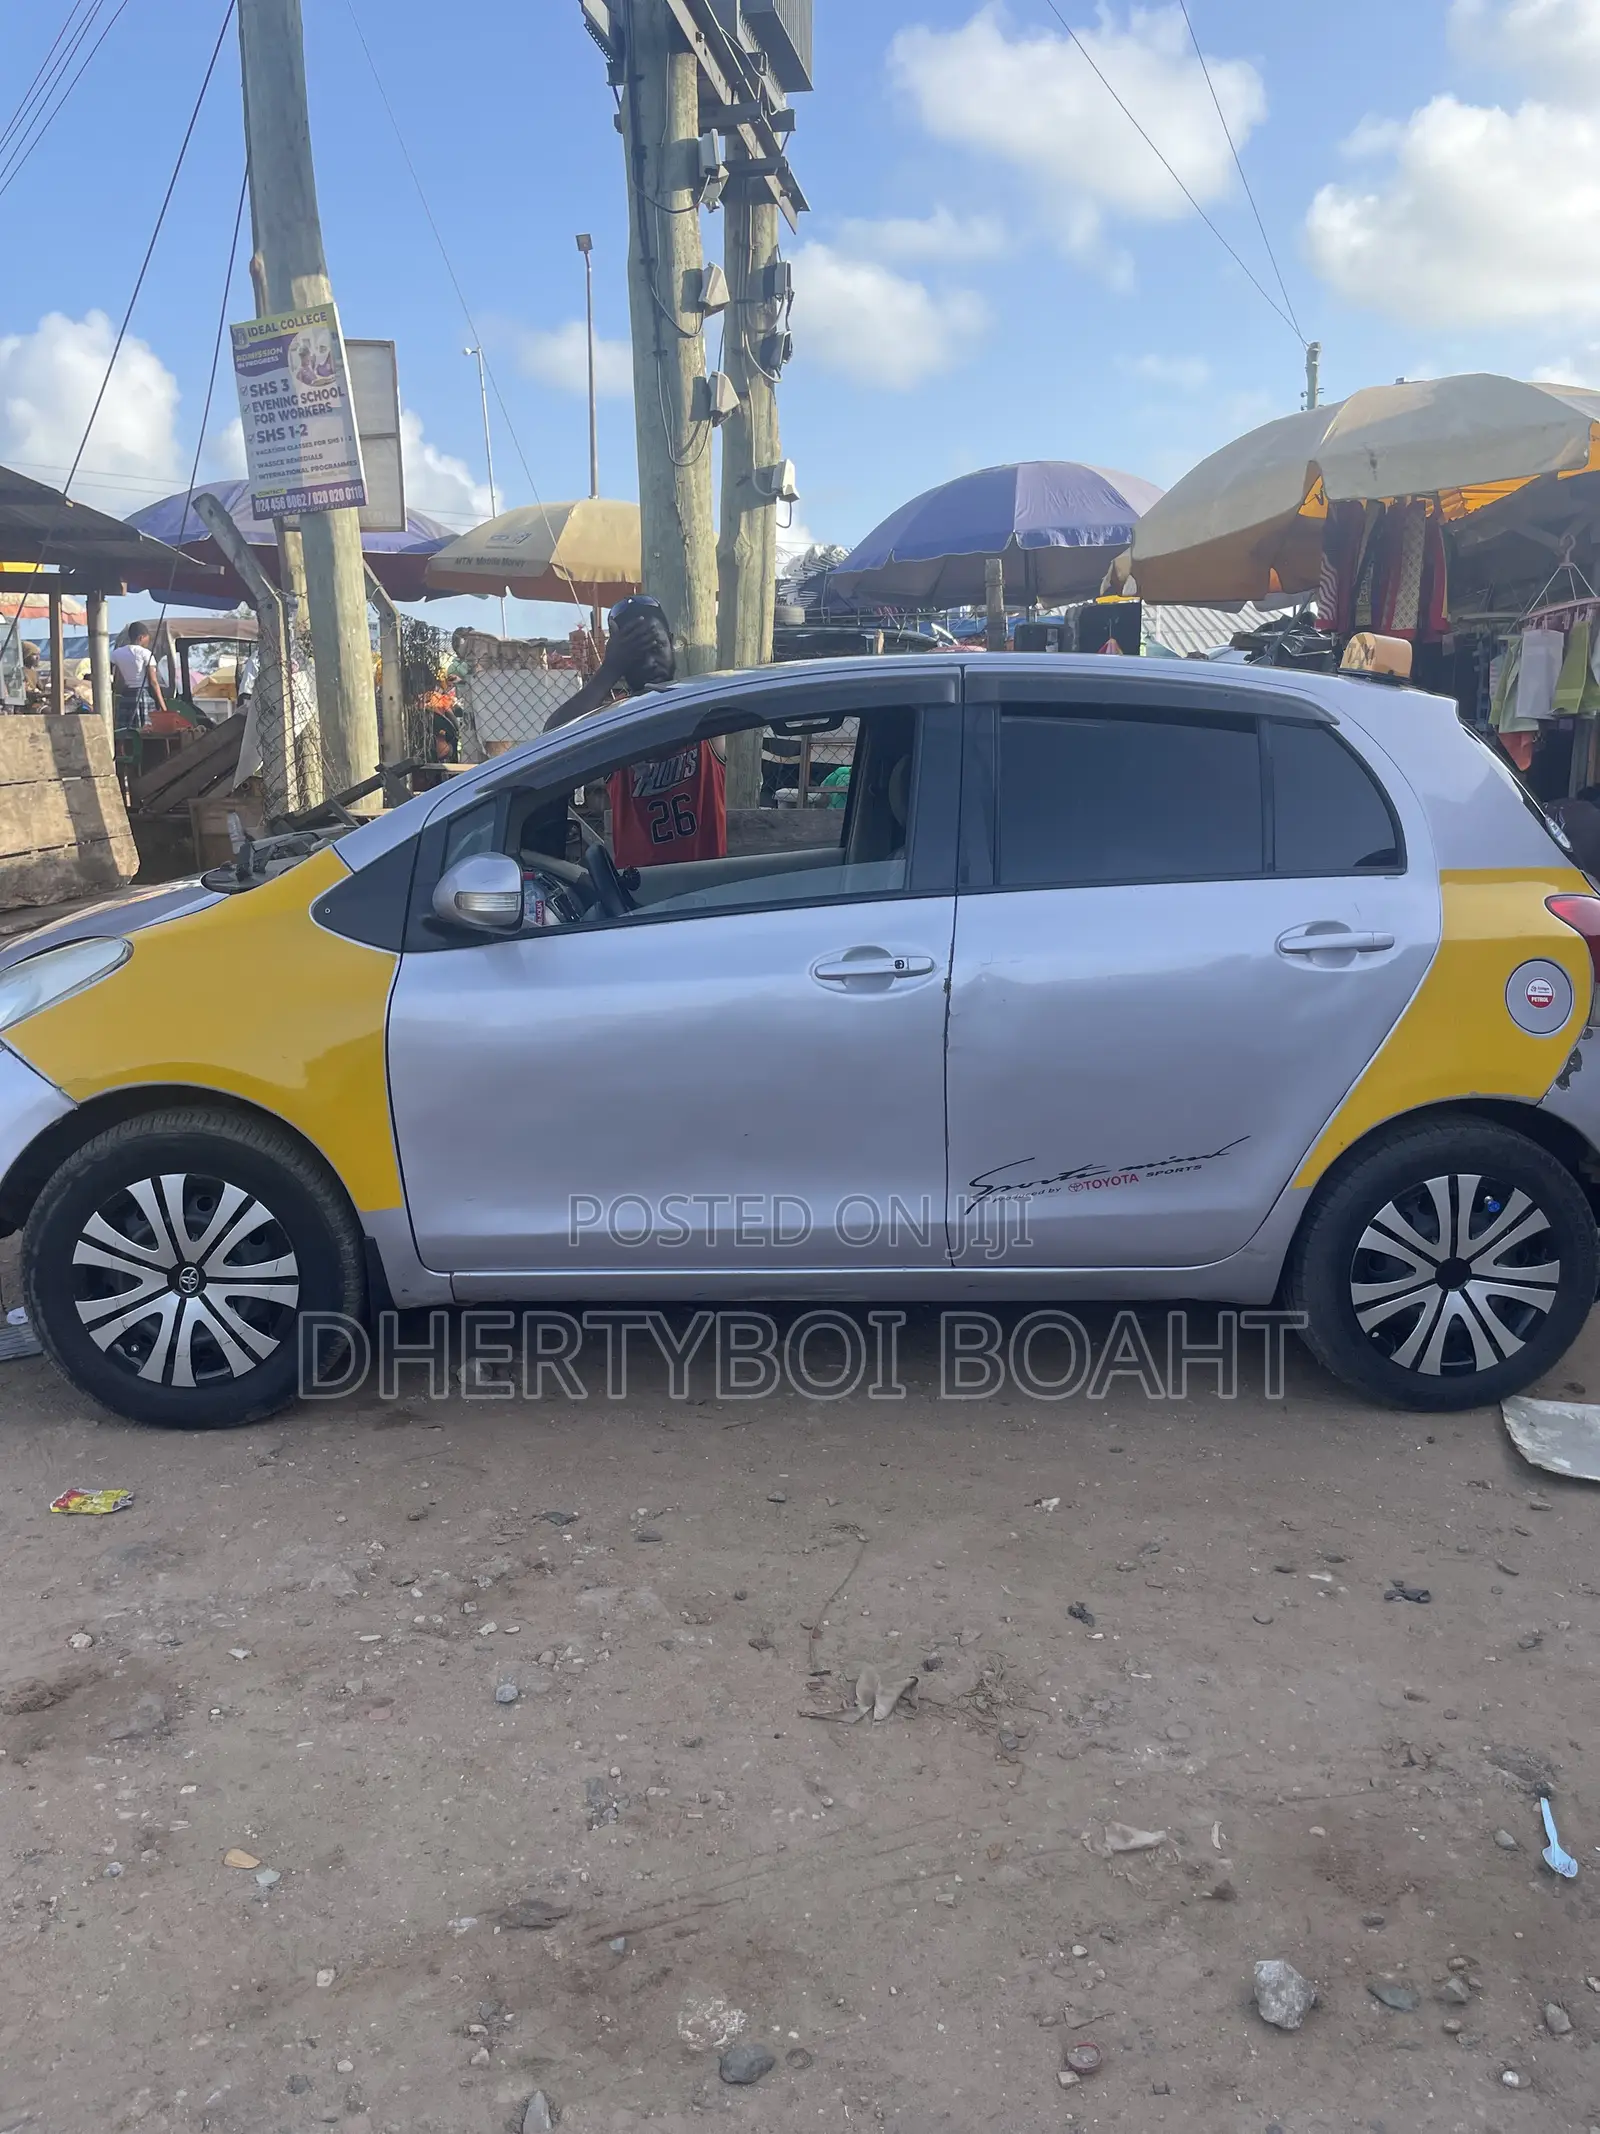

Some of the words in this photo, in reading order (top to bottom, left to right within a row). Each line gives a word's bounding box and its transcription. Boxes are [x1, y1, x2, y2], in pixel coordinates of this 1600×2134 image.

[247, 324, 278, 338] IDEAL
[280, 312, 327, 330] COLLEGE
[236, 346, 283, 363] ADMISSION
[246, 356, 279, 368] PROGRESS
[250, 381, 278, 398] SHS
[281, 378, 290, 392] 3
[252, 395, 299, 413] EVENING
[300, 386, 346, 404] SCHOOL
[254, 413, 276, 426] FOR
[279, 402, 333, 422] WORKERS
[257, 427, 285, 444] SHS
[288, 424, 308, 438] 1-2
[287, 441, 313, 452] CLASSES
[257, 460, 285, 469] WASSCE
[286, 453, 323, 465] REMEDIALS
[258, 467, 309, 480] INTERNATIONAL
[310, 460, 358, 472] PROGRAMMES
[255, 500, 270, 513] 024
[270, 498, 286, 511] 456
[312, 491, 328, 505] 020
[329, 488, 345, 502] 020
[455, 556, 473, 566] MTN
[476, 556, 500, 567] Mobile
[501, 557, 525, 568] Money
[647, 793, 697, 844] 26
[1084, 1173, 1139, 1191] TOYOTA
[1146, 1164, 1202, 1178] SPORTS
